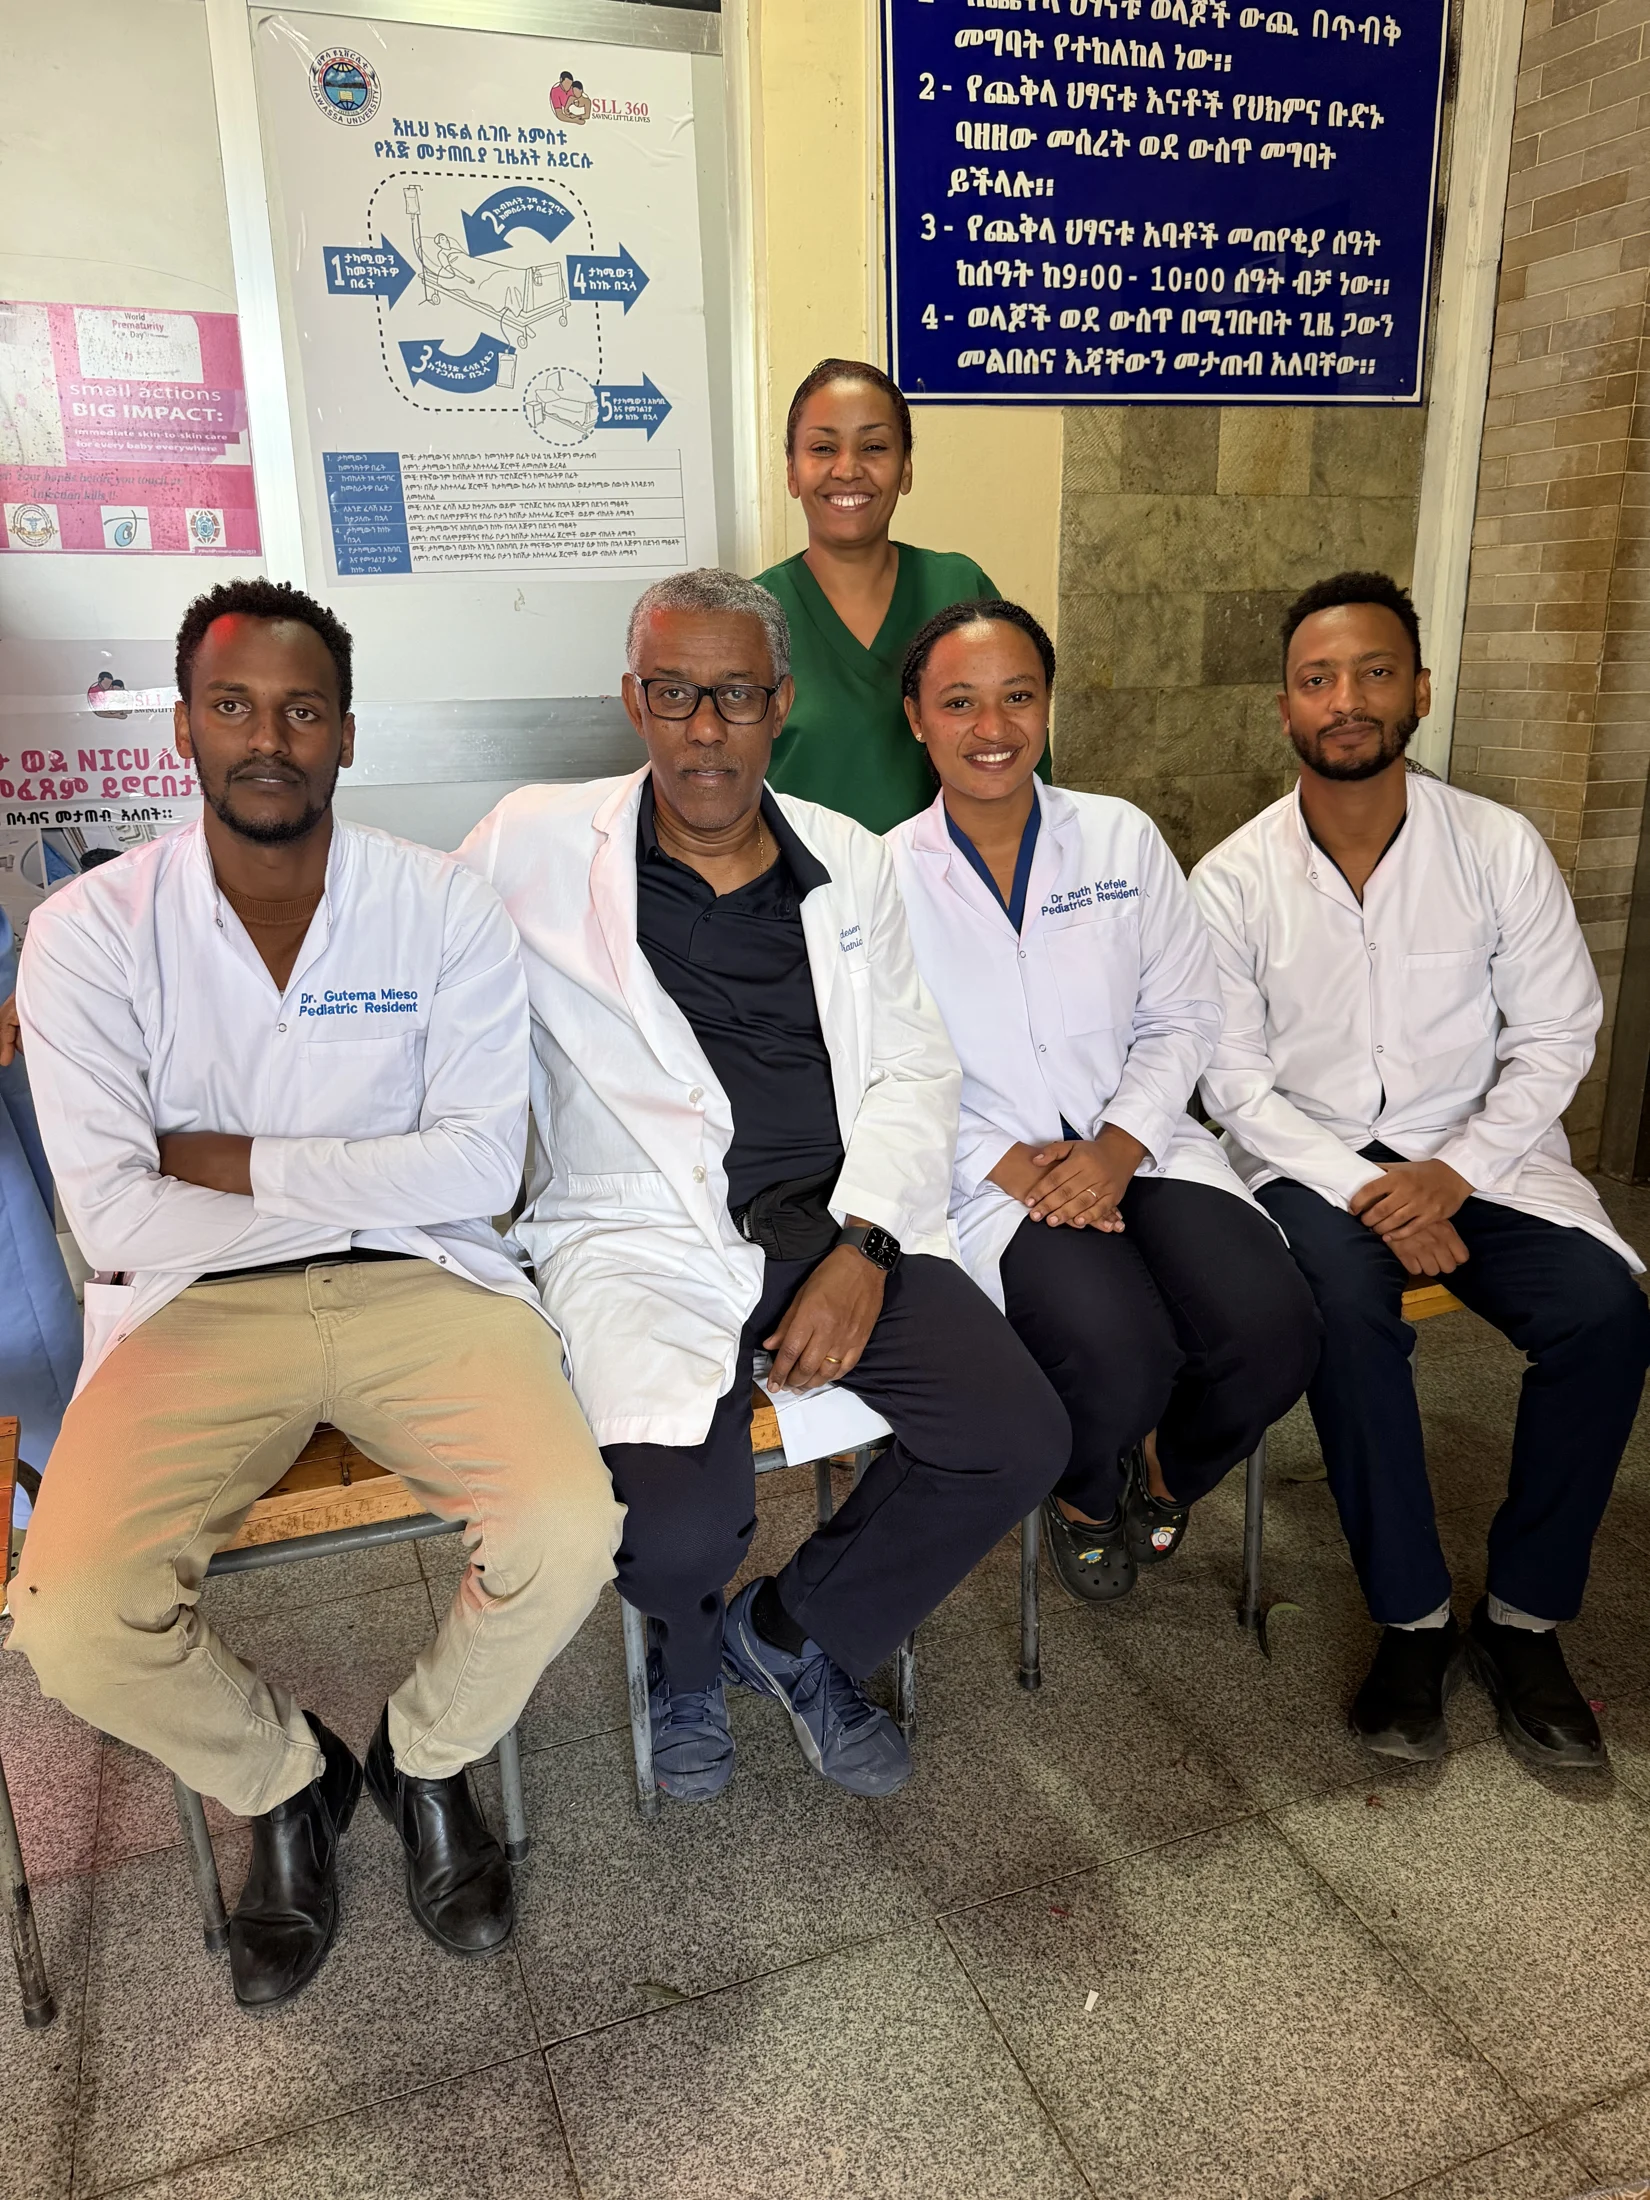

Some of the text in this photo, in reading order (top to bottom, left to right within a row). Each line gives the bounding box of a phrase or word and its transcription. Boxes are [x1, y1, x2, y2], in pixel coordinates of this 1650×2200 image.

[1239, 8, 1299, 36] ውጪ
[1312, 9, 1401, 47] በጥብቅ
[954, 29, 1044, 59] መግባት
[1054, 33, 1166, 69] የተከለከለ
[312, 85, 379, 124] HAWASSA UNIVERSITY
[592, 98, 649, 116] SLL 360
[966, 74, 1058, 108] የጨቅላ
[1066, 82, 1138, 112] ህፃናቱ
[1146, 86, 1224, 118] እናቶች
[1232, 94, 1321, 126] የህክምና
[1328, 101, 1385, 130] ቡድኑ
[392, 117, 568, 146] እዚህ ክፍል ሲገቡ አምስቱ
[955, 121, 1336, 170] ባዘዘው መሰረት ወደ ውስጥ መግባት
[374, 139, 410, 160] የእጅ
[416, 142, 488, 164] መታጠቢያ
[547, 150, 594, 169] አይርሱ
[481, 210, 506, 235] 2
[967, 213, 1057, 244] የጨቅላ
[1065, 218, 1135, 246] ህፃናቱ
[1143, 221, 1219, 250] አባቶች
[1228, 228, 1326, 258] መጠየቂያ
[1332, 230, 1381, 256] ሰዓት
[331, 254, 345, 286] 1
[574, 263, 586, 294] 4
[956, 259, 1034, 288] ከሰዓት
[1234, 268, 1284, 294] ሰዓት
[1292, 269, 1332, 296] ብቻ
[112, 319, 164, 333] Prematurity
[124, 312, 146, 321] World
[967, 303, 1052, 333] ወላጆች
[1059, 306, 1100, 332] ወደ
[1109, 307, 1173, 333] ውስጥ
[1181, 309, 1292, 336] በሚገቡበት
[1300, 312, 1334, 338] ጊዜ
[1340, 312, 1394, 338] ጋውን
[411, 344, 433, 374] 3
[957, 348, 1056, 374] መልበስና
[1065, 348, 1166, 376] እጃቸውን
[1174, 350, 1263, 376] መታጠብ
[69, 383, 222, 401] small actions
[72, 402, 224, 422] BIG IMPACT:
[600, 392, 613, 422] 5
[74, 428, 135, 438] immediate
[204, 433, 228, 441] care
[126, 441, 152, 452] baby
[155, 444, 218, 452] everywhere
[78, 748, 150, 772] NICU
[55, 810, 112, 824] መታጠብ
[1041, 886, 1139, 916] Pediatrics Resident
[1050, 878, 1127, 904] Dr Ruth Kefele
[298, 1001, 418, 1017] Pediatric Resident
[300, 988, 418, 1004] Dr. Gutema Mieso
